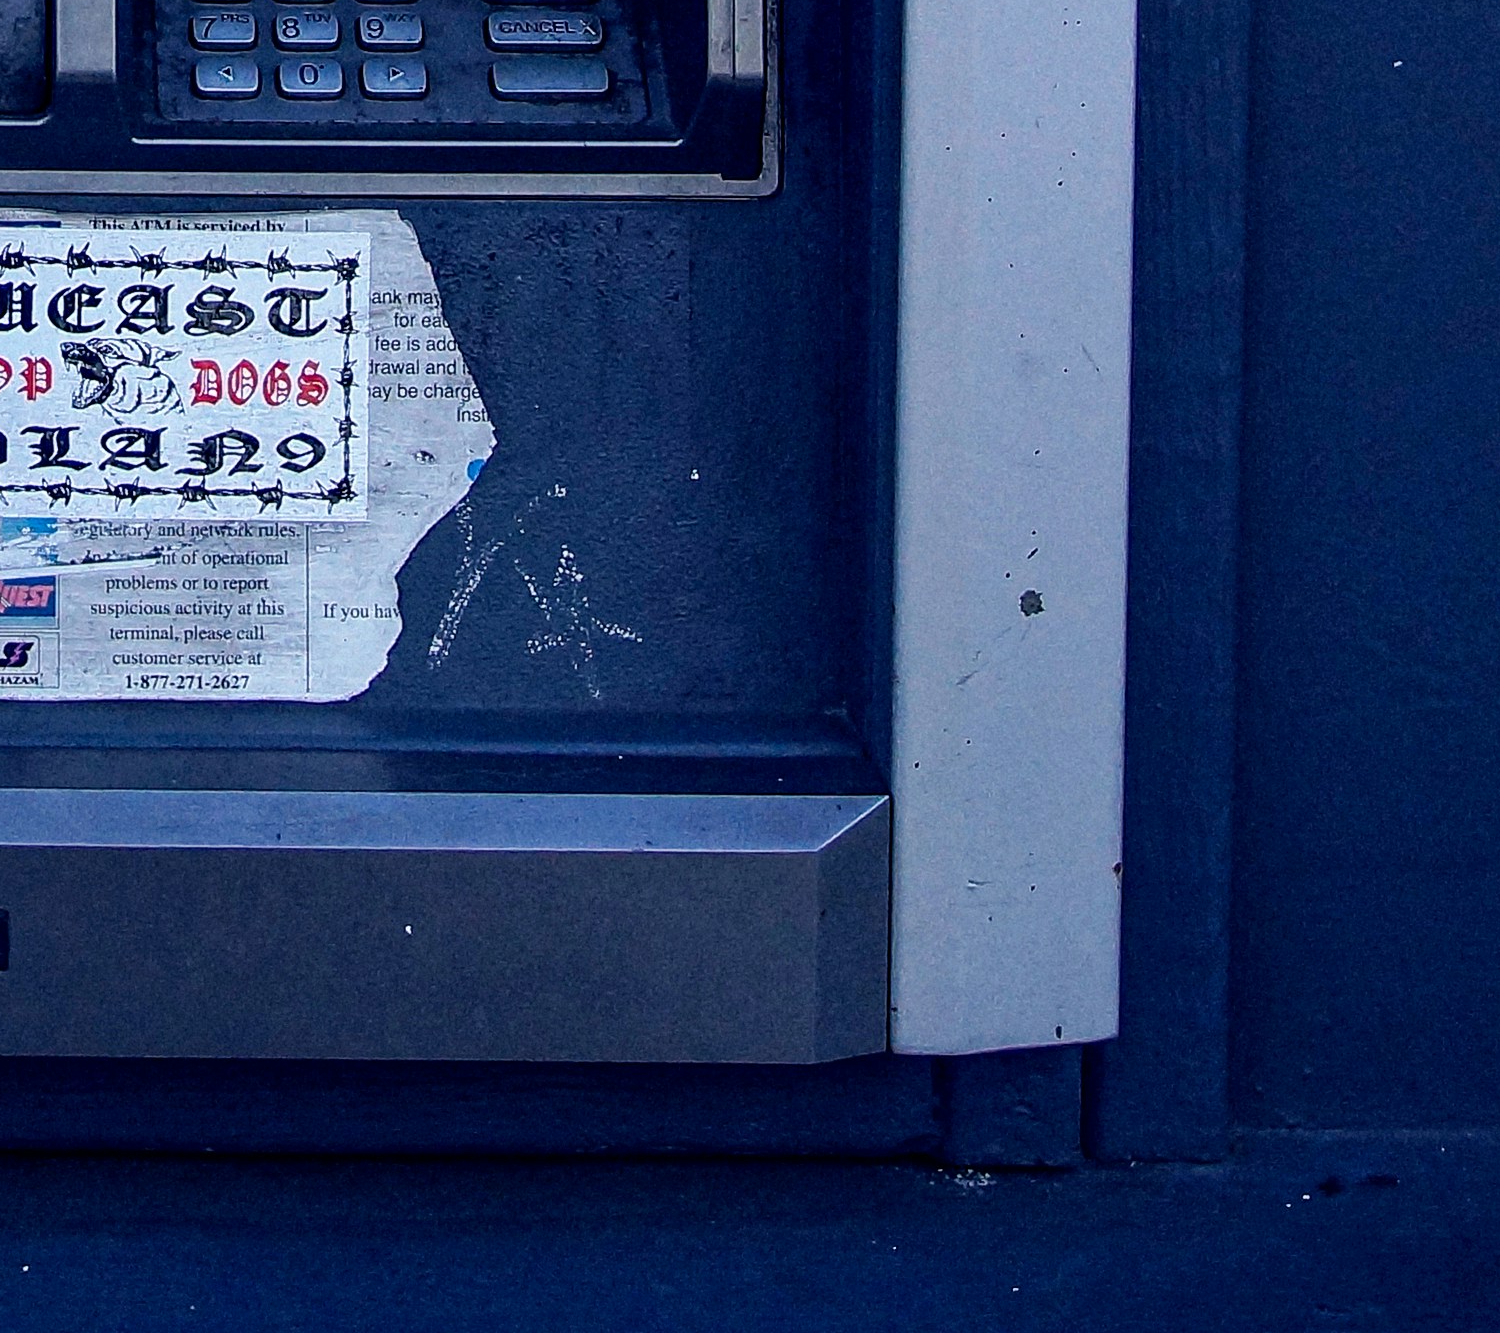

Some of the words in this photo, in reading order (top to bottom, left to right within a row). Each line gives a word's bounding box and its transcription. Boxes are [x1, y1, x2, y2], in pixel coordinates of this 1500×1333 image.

[200, 17, 217, 39] 7
[220, 13, 250, 24] PRS
[281, 17, 300, 39] 8
[304, 12, 332, 24] TUV
[366, 18, 385, 39] 9
[499, 19, 577, 35] CANCEL
[300, 64, 320, 86] 0
[89, 219, 125, 231] This
[131, 219, 170, 231] ATM
[177, 219, 190, 231] is
[194, 220, 260, 232] serviced
[394, 312, 416, 328] for
[375, 335, 401, 351] fee
[407, 335, 421, 351] is
[425, 358, 457, 375] and
[190, 358, 330, 407] DOGS
[368, 384, 392, 403] ay
[397, 383, 419, 399] be
[457, 406, 490, 423] Inst
[158, 523, 186, 538] and
[190, 522, 253, 539] network
[258, 523, 301, 539] rules.
[181, 549, 202, 566] of
[202, 549, 289, 569] operational
[106, 575, 178, 592] problems
[182, 577, 199, 591] or
[203, 577, 218, 591] to
[222, 577, 270, 593] report
[90, 600, 171, 618] suspicious
[175, 600, 233, 619] activity
[238, 602, 252, 616] at
[256, 599, 285, 616] this
[323, 603, 337, 619] If
[339, 606, 370, 624] you
[109, 625, 180, 643] terminal,
[183, 625, 232, 643] please
[236, 625, 265, 641] call
[112, 652, 183, 666] customer
[187, 651, 242, 666] service
[248, 652, 263, 666] at
[125, 674, 249, 691] 1-877-271-2627
